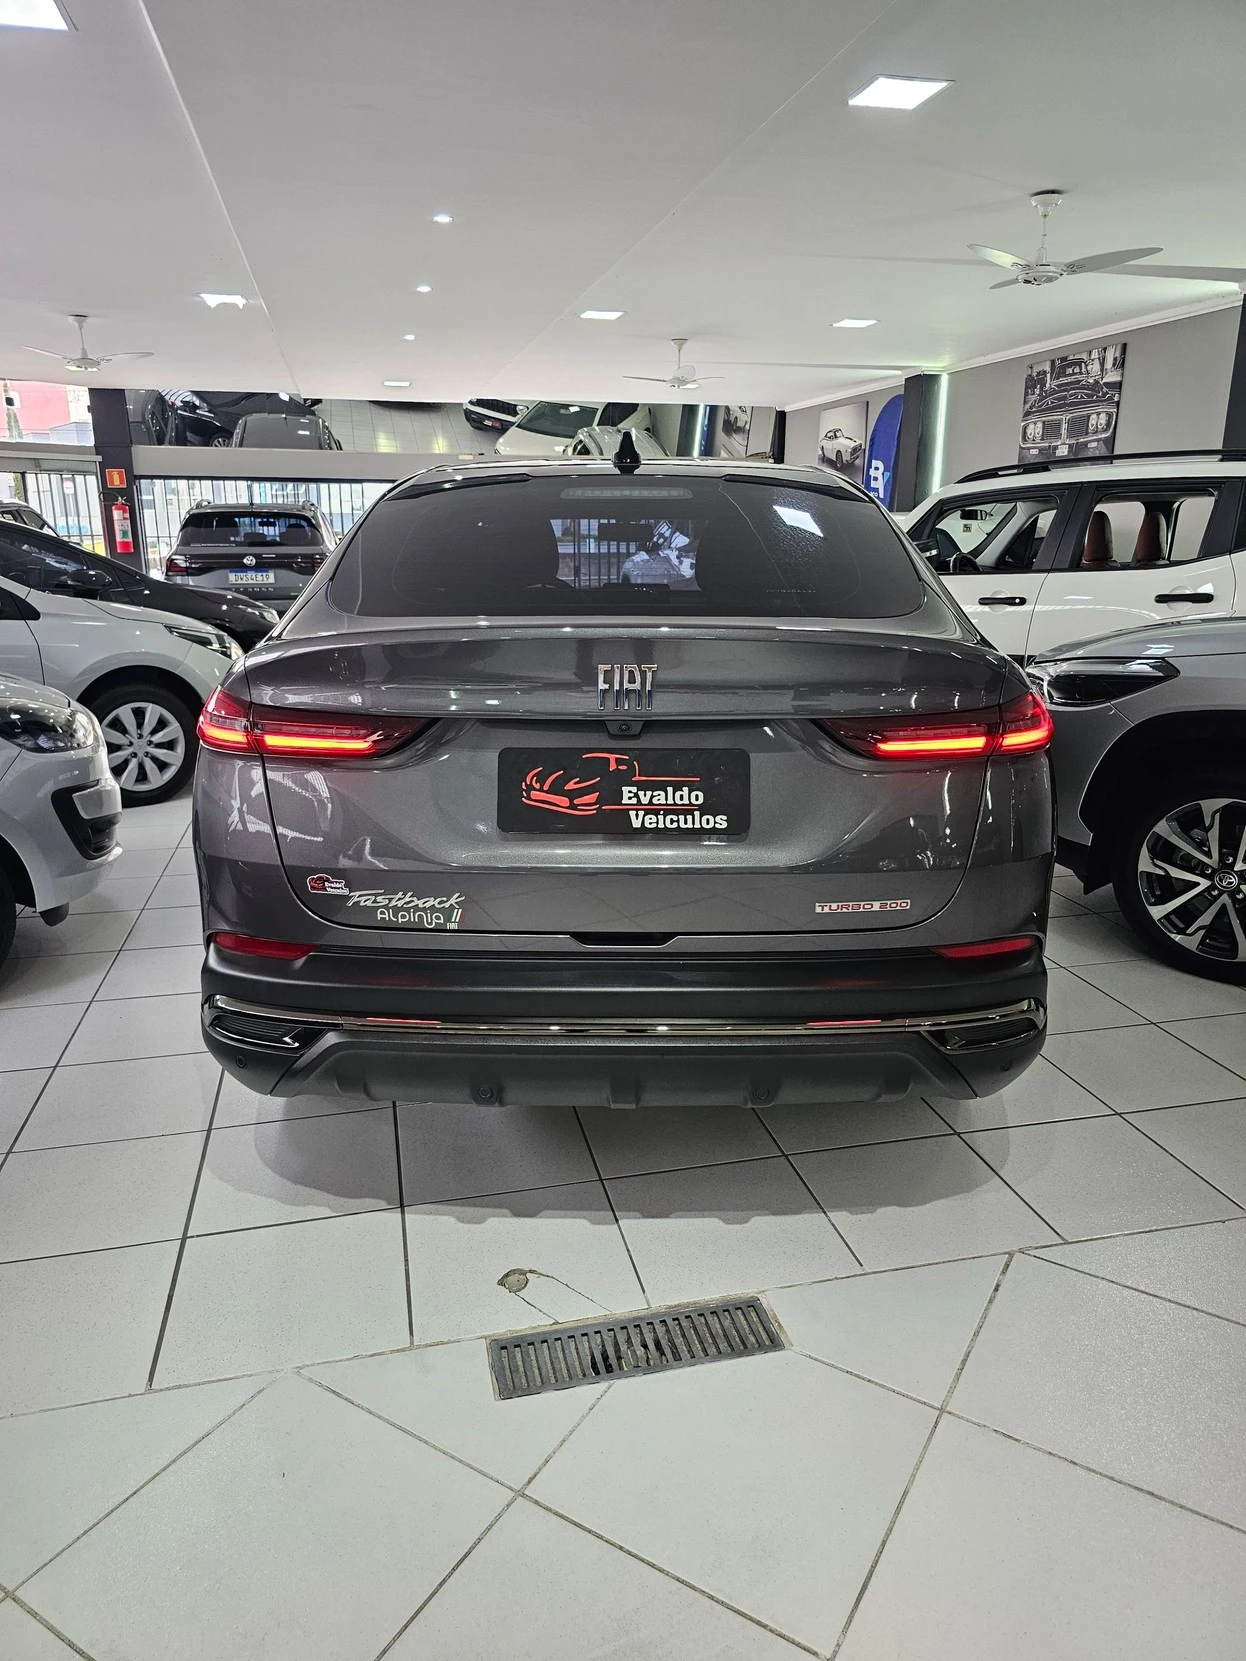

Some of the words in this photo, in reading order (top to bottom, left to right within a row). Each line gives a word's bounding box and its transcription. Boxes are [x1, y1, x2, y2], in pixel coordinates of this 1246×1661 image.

[234, 573, 270, 583] DWS4E19
[597, 664, 659, 710] FIAT
[621, 786, 704, 805] Evaldo
[628, 810, 728, 829] Veículos
[346, 889, 466, 909] Fastback
[817, 902, 874, 912] TURBO
[879, 901, 909, 910] 200
